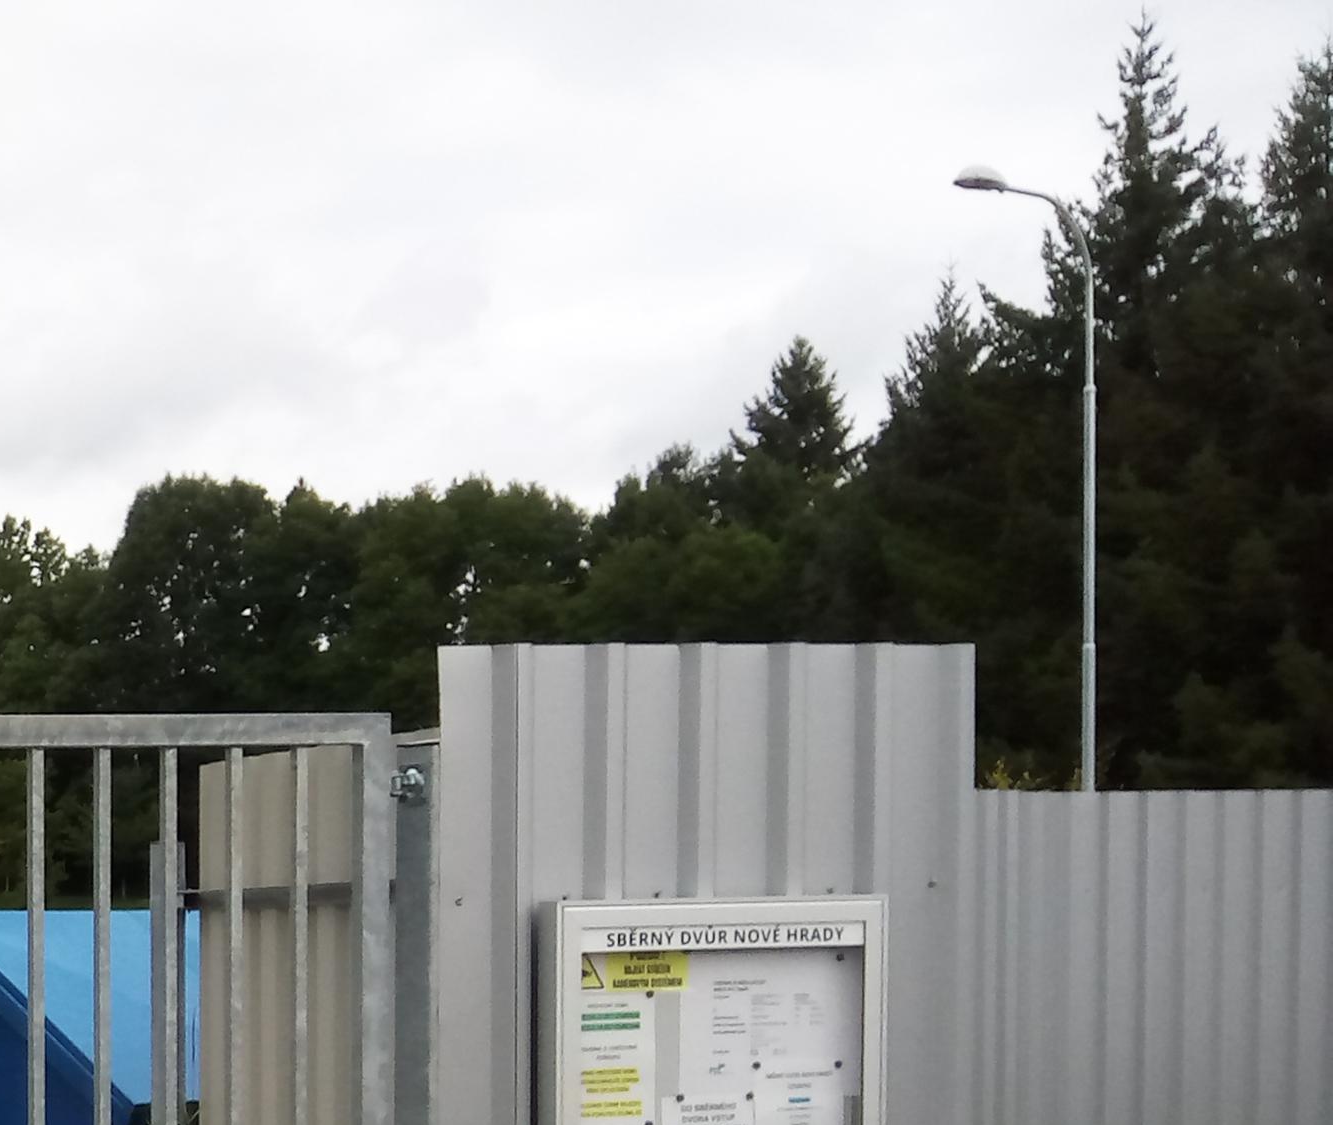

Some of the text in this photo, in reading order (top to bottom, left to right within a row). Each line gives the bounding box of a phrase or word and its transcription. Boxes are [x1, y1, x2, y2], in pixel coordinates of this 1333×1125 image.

[607, 924, 844, 948] SBĚRNÝ DVŮR NOVÉ HRADY
